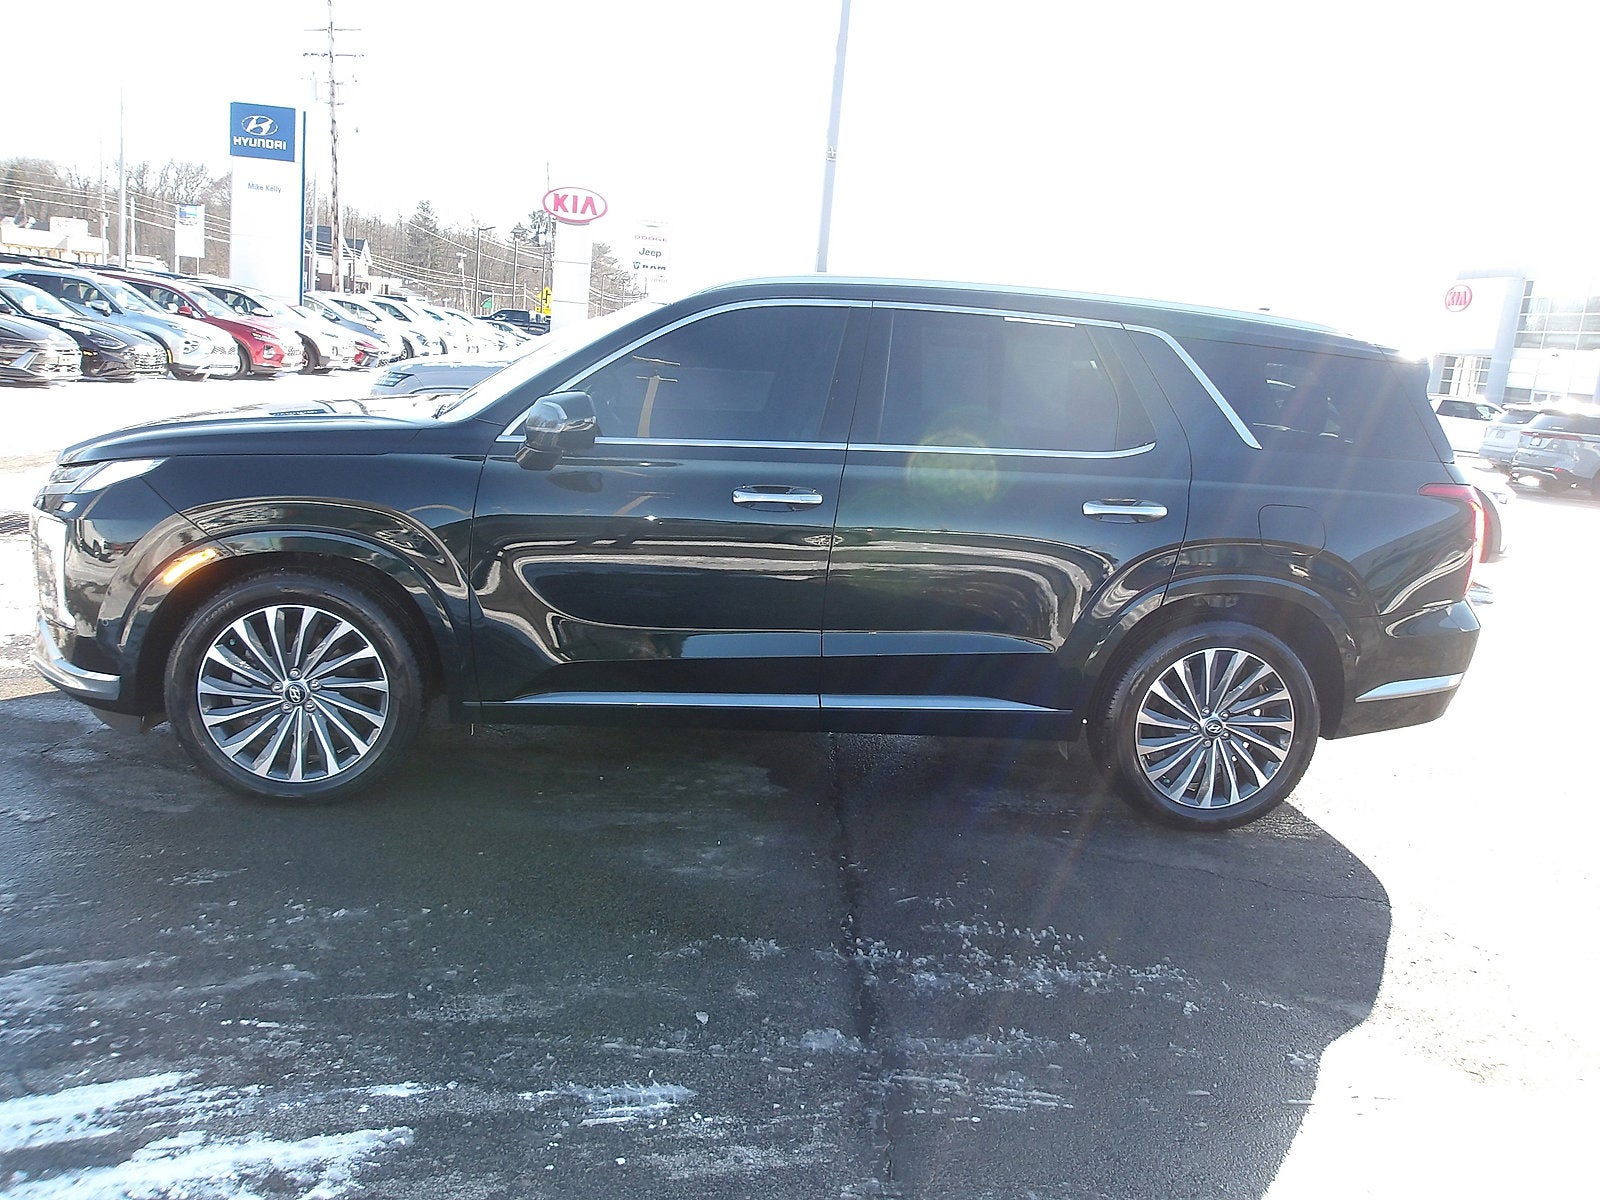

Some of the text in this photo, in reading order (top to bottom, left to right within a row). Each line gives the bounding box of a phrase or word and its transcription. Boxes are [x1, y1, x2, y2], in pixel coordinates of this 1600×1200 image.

[233, 135, 287, 151] HYUNDAI
[247, 182, 282, 194] Mike Kelly
[553, 193, 597, 216] KIA
[638, 247, 662, 258] Jeep
[1447, 291, 1467, 306] KIA
